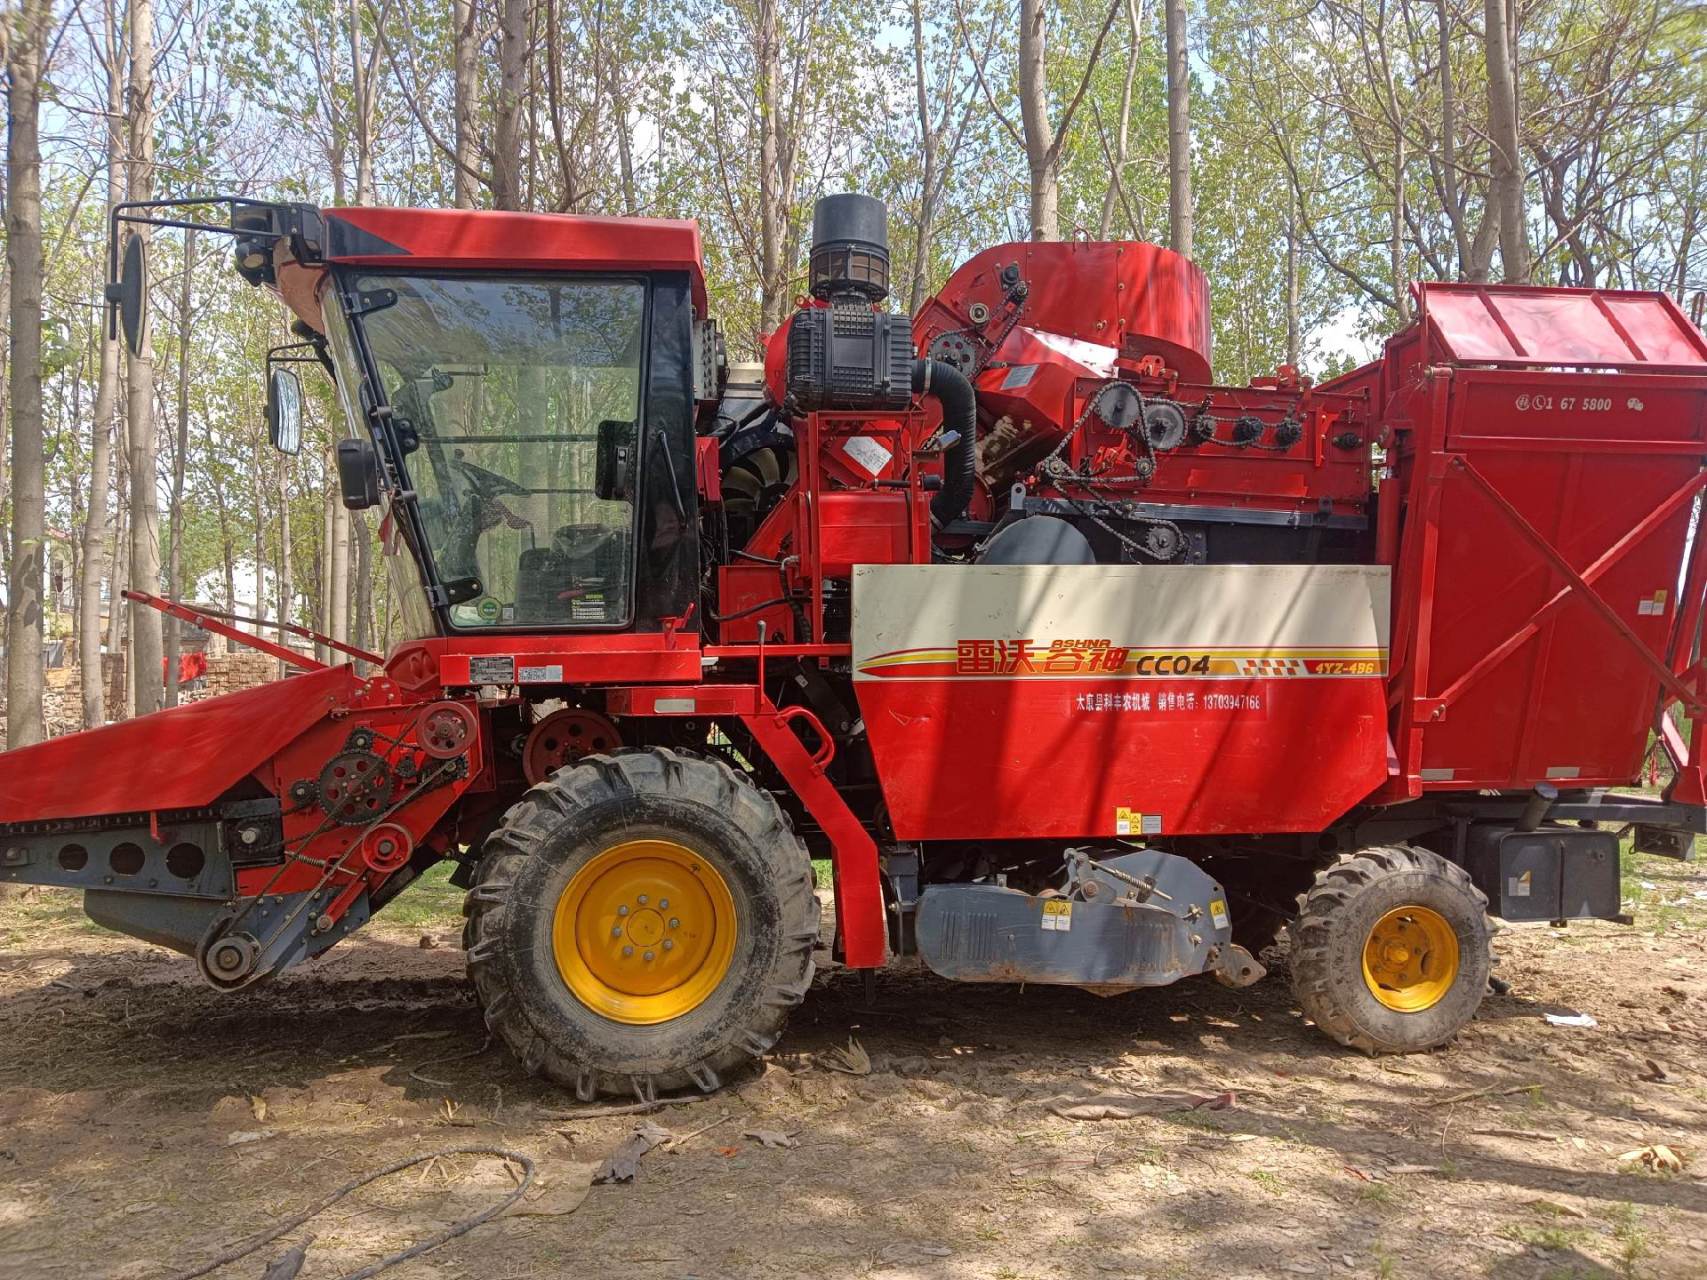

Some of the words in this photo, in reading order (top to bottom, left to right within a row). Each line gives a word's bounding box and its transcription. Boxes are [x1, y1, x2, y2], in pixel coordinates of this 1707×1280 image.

[1560, 397, 1576, 410] 67
[1582, 398, 1612, 411] 5800
[957, 639, 1035, 673] 雷沃
[1043, 647, 1130, 673] 谷神
